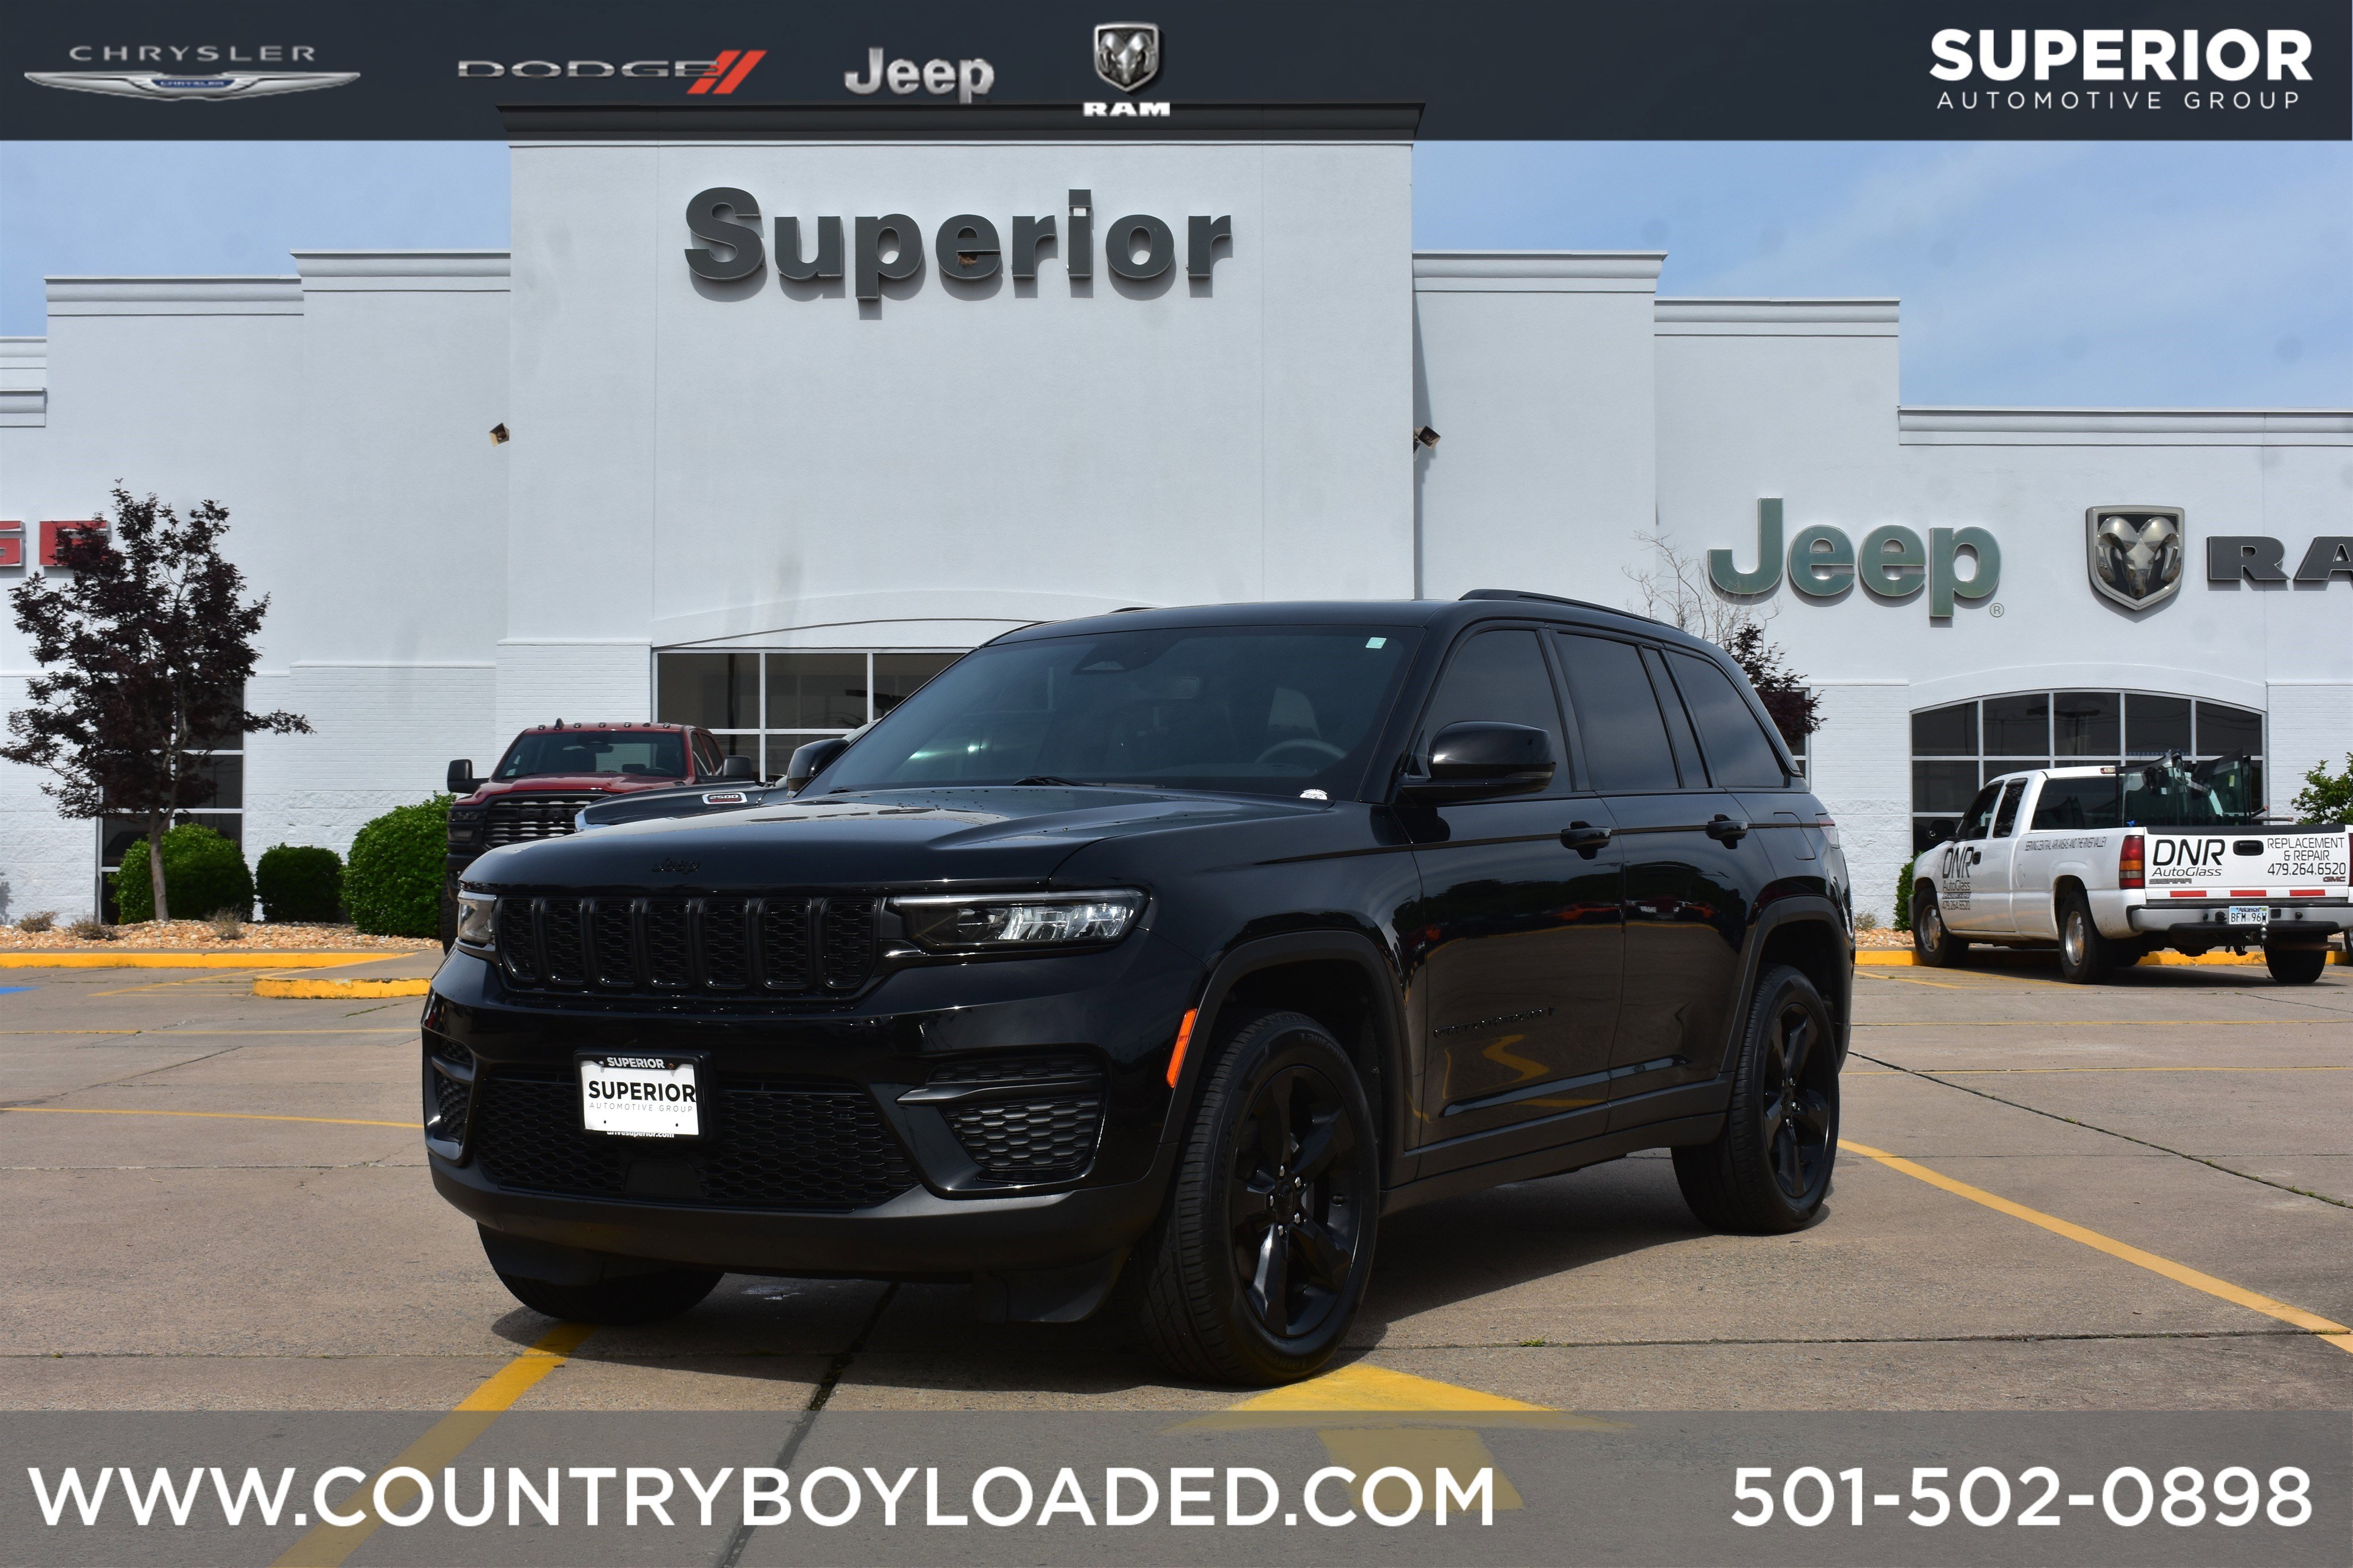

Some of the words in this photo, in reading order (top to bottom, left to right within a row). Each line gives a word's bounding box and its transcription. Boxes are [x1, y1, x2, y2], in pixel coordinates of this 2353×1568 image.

[684, 187, 1232, 301] Superior
[1707, 497, 2002, 618] Jeep
[2267, 837, 2345, 849] REPLACEMENT
[2153, 839, 2225, 866] DNR
[2283, 850, 2291, 861] &
[2293, 850, 2329, 861] REPAIR
[1942, 847, 1974, 879] DNR
[2267, 863, 2346, 876] 479.264.6520
[2151, 867, 2222, 877] AutoGlass
[607, 1057, 665, 1069] SUPERIOR
[588, 1080, 697, 1103] SUPERIOR
[589, 1102, 653, 1111] AUTOMOTIVE
